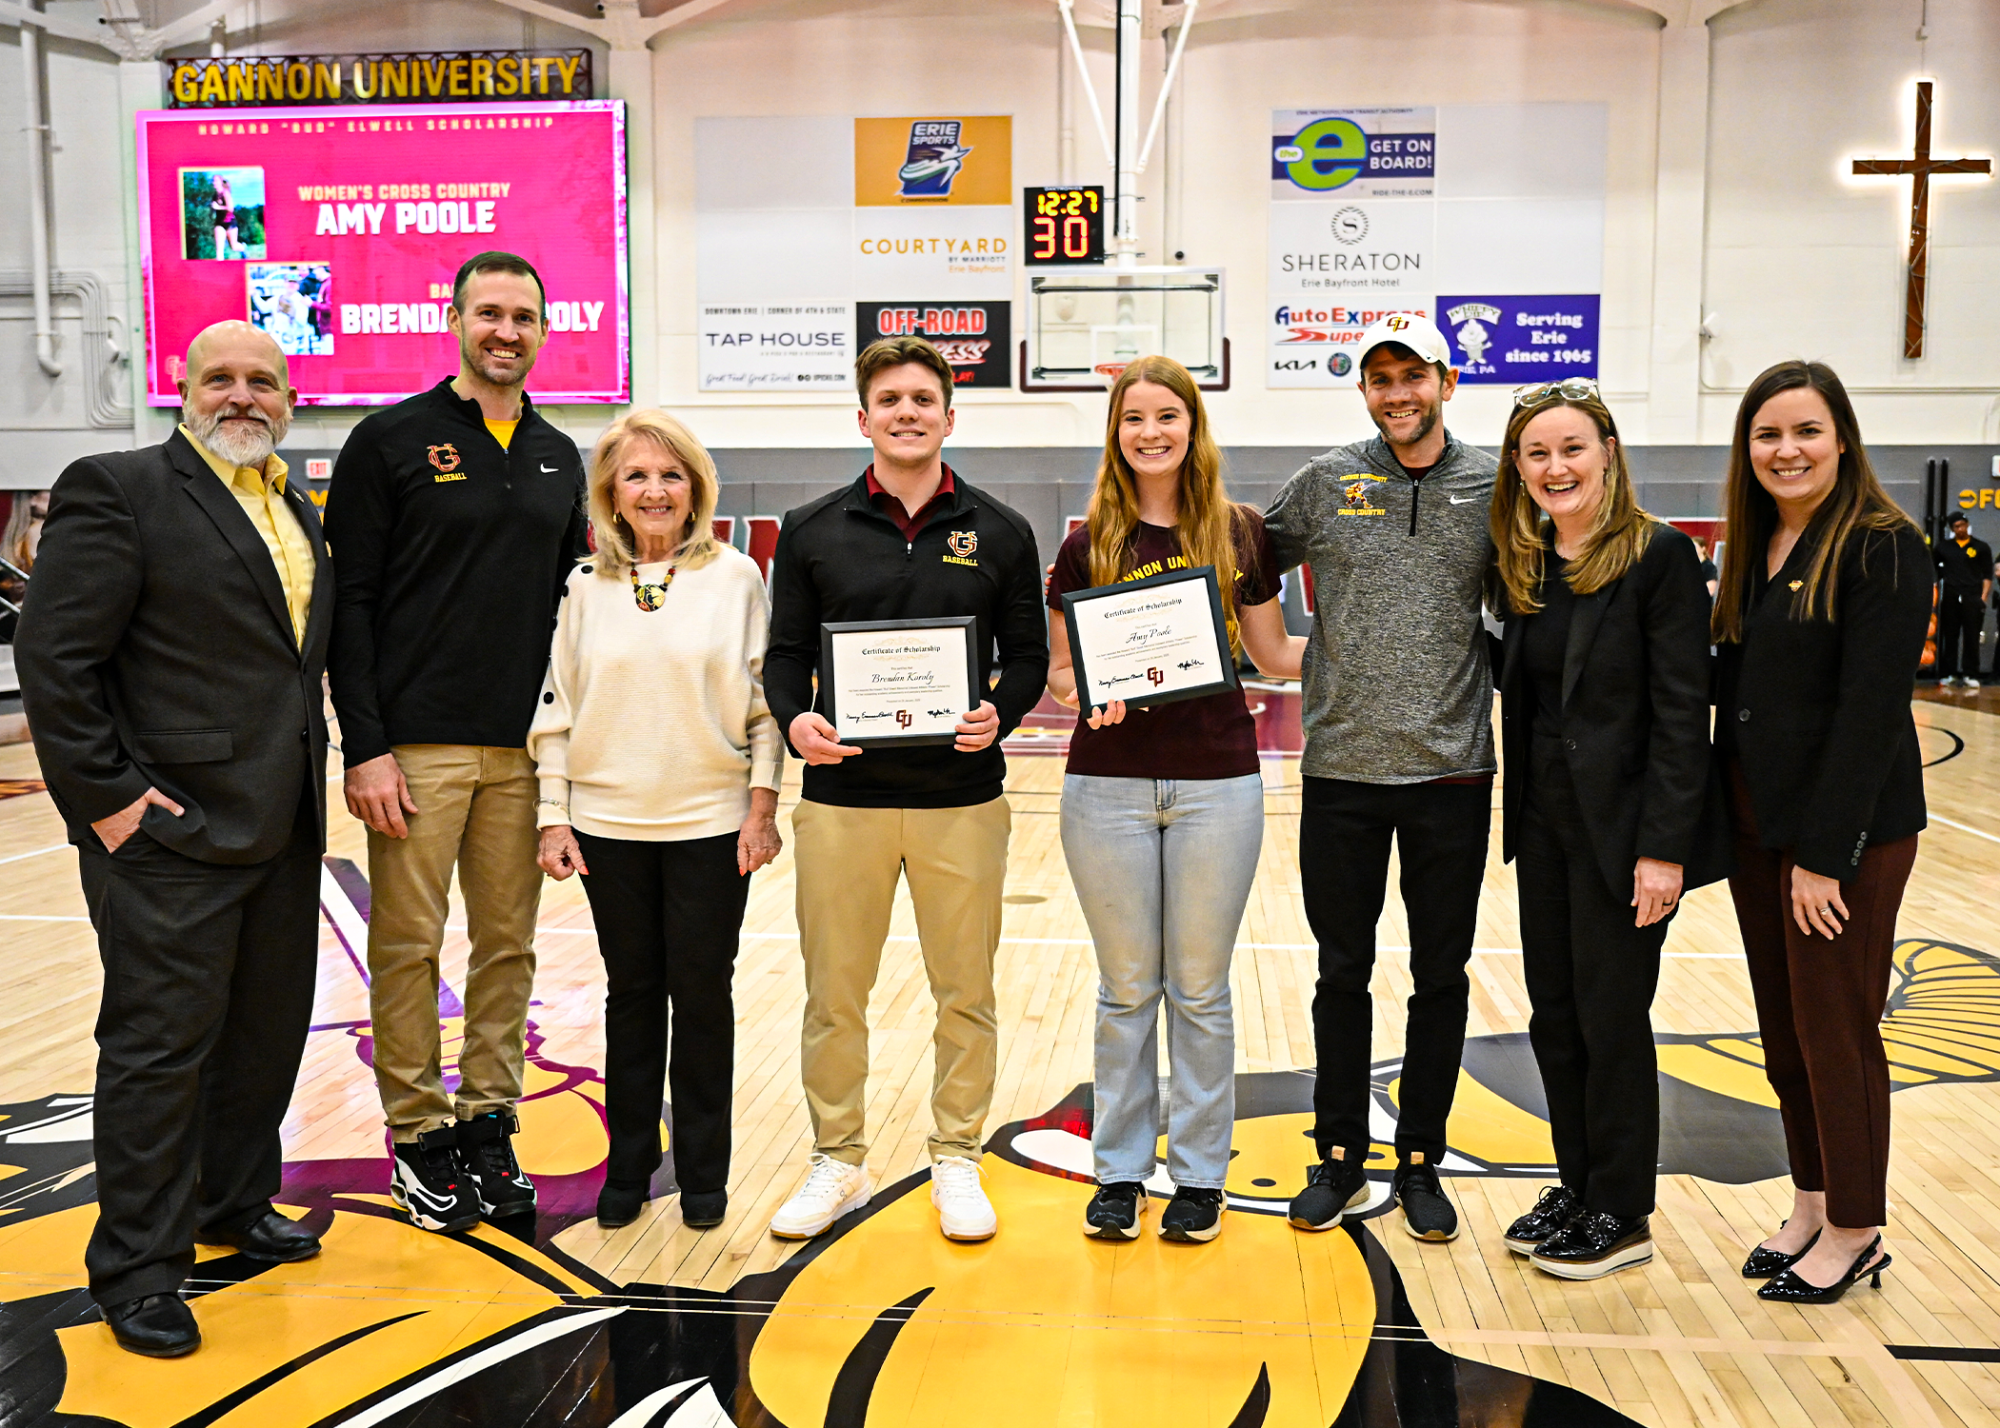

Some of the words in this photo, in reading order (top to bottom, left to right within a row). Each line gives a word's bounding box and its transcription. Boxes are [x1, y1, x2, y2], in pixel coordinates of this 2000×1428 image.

[174, 62, 341, 102] GANNON
[353, 56, 580, 98] UNIVERSITY
[198, 123, 269, 135] HOWARD
[347, 120, 414, 132] ELWELL
[426, 117, 553, 131] SCHOLARSHIP
[914, 123, 958, 136] ERIE
[912, 136, 956, 146] SPORTS
[1370, 140, 1402, 153] GET
[1407, 139, 1432, 152] ON
[1280, 148, 1298, 158] the
[1370, 156, 1432, 170] BOARD!
[298, 185, 373, 201] WOMEN'S
[378, 184, 431, 200] CROSS
[436, 182, 510, 198] COUNTRY
[1038, 190, 1098, 216] 12:27
[315, 202, 386, 236] AMY
[395, 201, 496, 234] POOLE
[1034, 216, 1088, 258] 30
[860, 238, 1007, 254] COURTYARD
[968, 265, 1006, 274] Bayfront
[1282, 253, 1420, 272] SHERATON
[1302, 279, 1320, 287] Erie
[1324, 278, 1368, 290] Bayfront
[1372, 278, 1400, 287] Hotel
[878, 308, 987, 336] OFF-ROAD
[1516, 312, 1583, 328] Serving
[706, 333, 754, 346] TAP
[761, 332, 846, 346] HOUSE
[1531, 330, 1567, 344] Erie
[1505, 348, 1550, 363] since
[1553, 349, 1592, 364] 1965
[1274, 360, 1316, 370] KIA
[1480, 365, 1496, 374] PA
[308, 462, 327, 476] EXIT
[434, 473, 468, 483] BASEBALL
[942, 555, 978, 566] BASEBALL
[1104, 608, 1136, 619] Certificate
[1145, 598, 1182, 610] Scholarship
[1126, 630, 1148, 644] Amy
[1149, 625, 1172, 637] Poole
[871, 672, 905, 683] Brendan
[907, 670, 934, 685] Karoly
